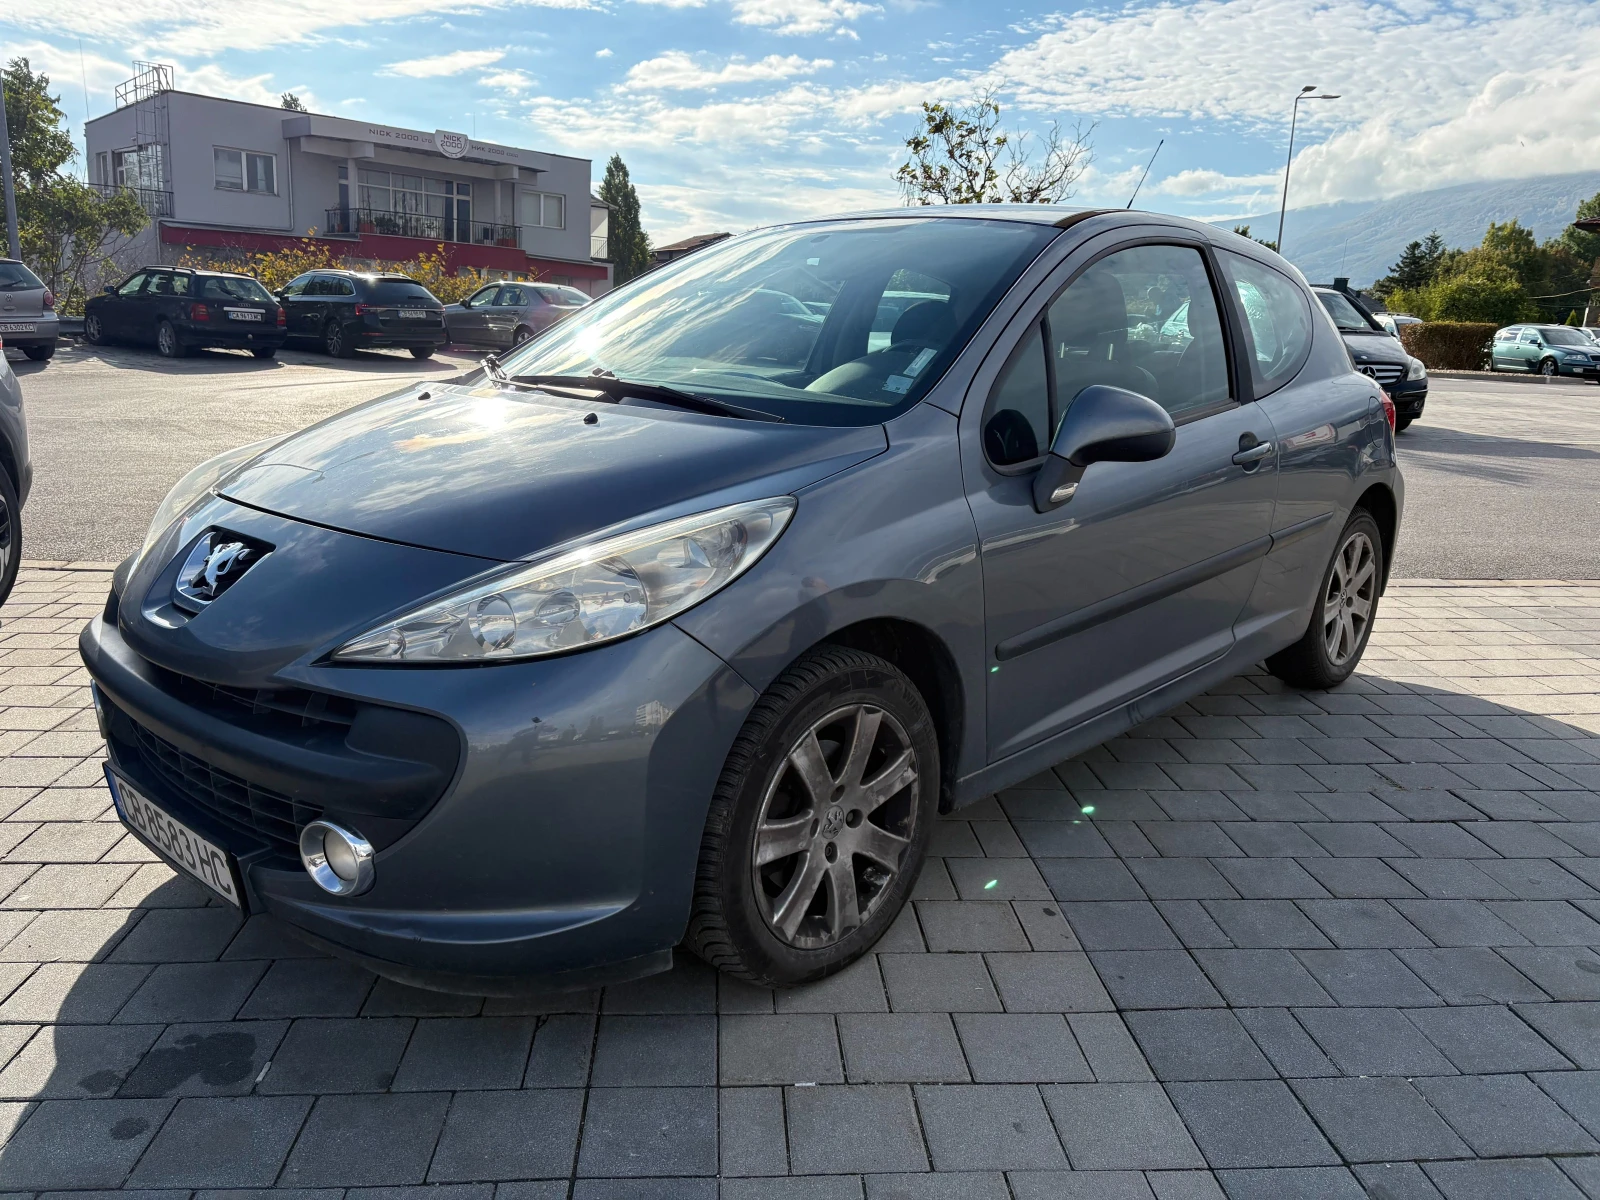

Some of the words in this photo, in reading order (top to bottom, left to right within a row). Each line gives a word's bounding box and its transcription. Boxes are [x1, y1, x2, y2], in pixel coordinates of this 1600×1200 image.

[369, 128, 392, 138] NICK
[395, 132, 419, 142] 2000
[443, 134, 462, 143] NICK
[440, 139, 462, 149] 2000
[488, 147, 505, 155] 2000
[144, 803, 198, 871] 8583
[193, 837, 232, 896] HC
